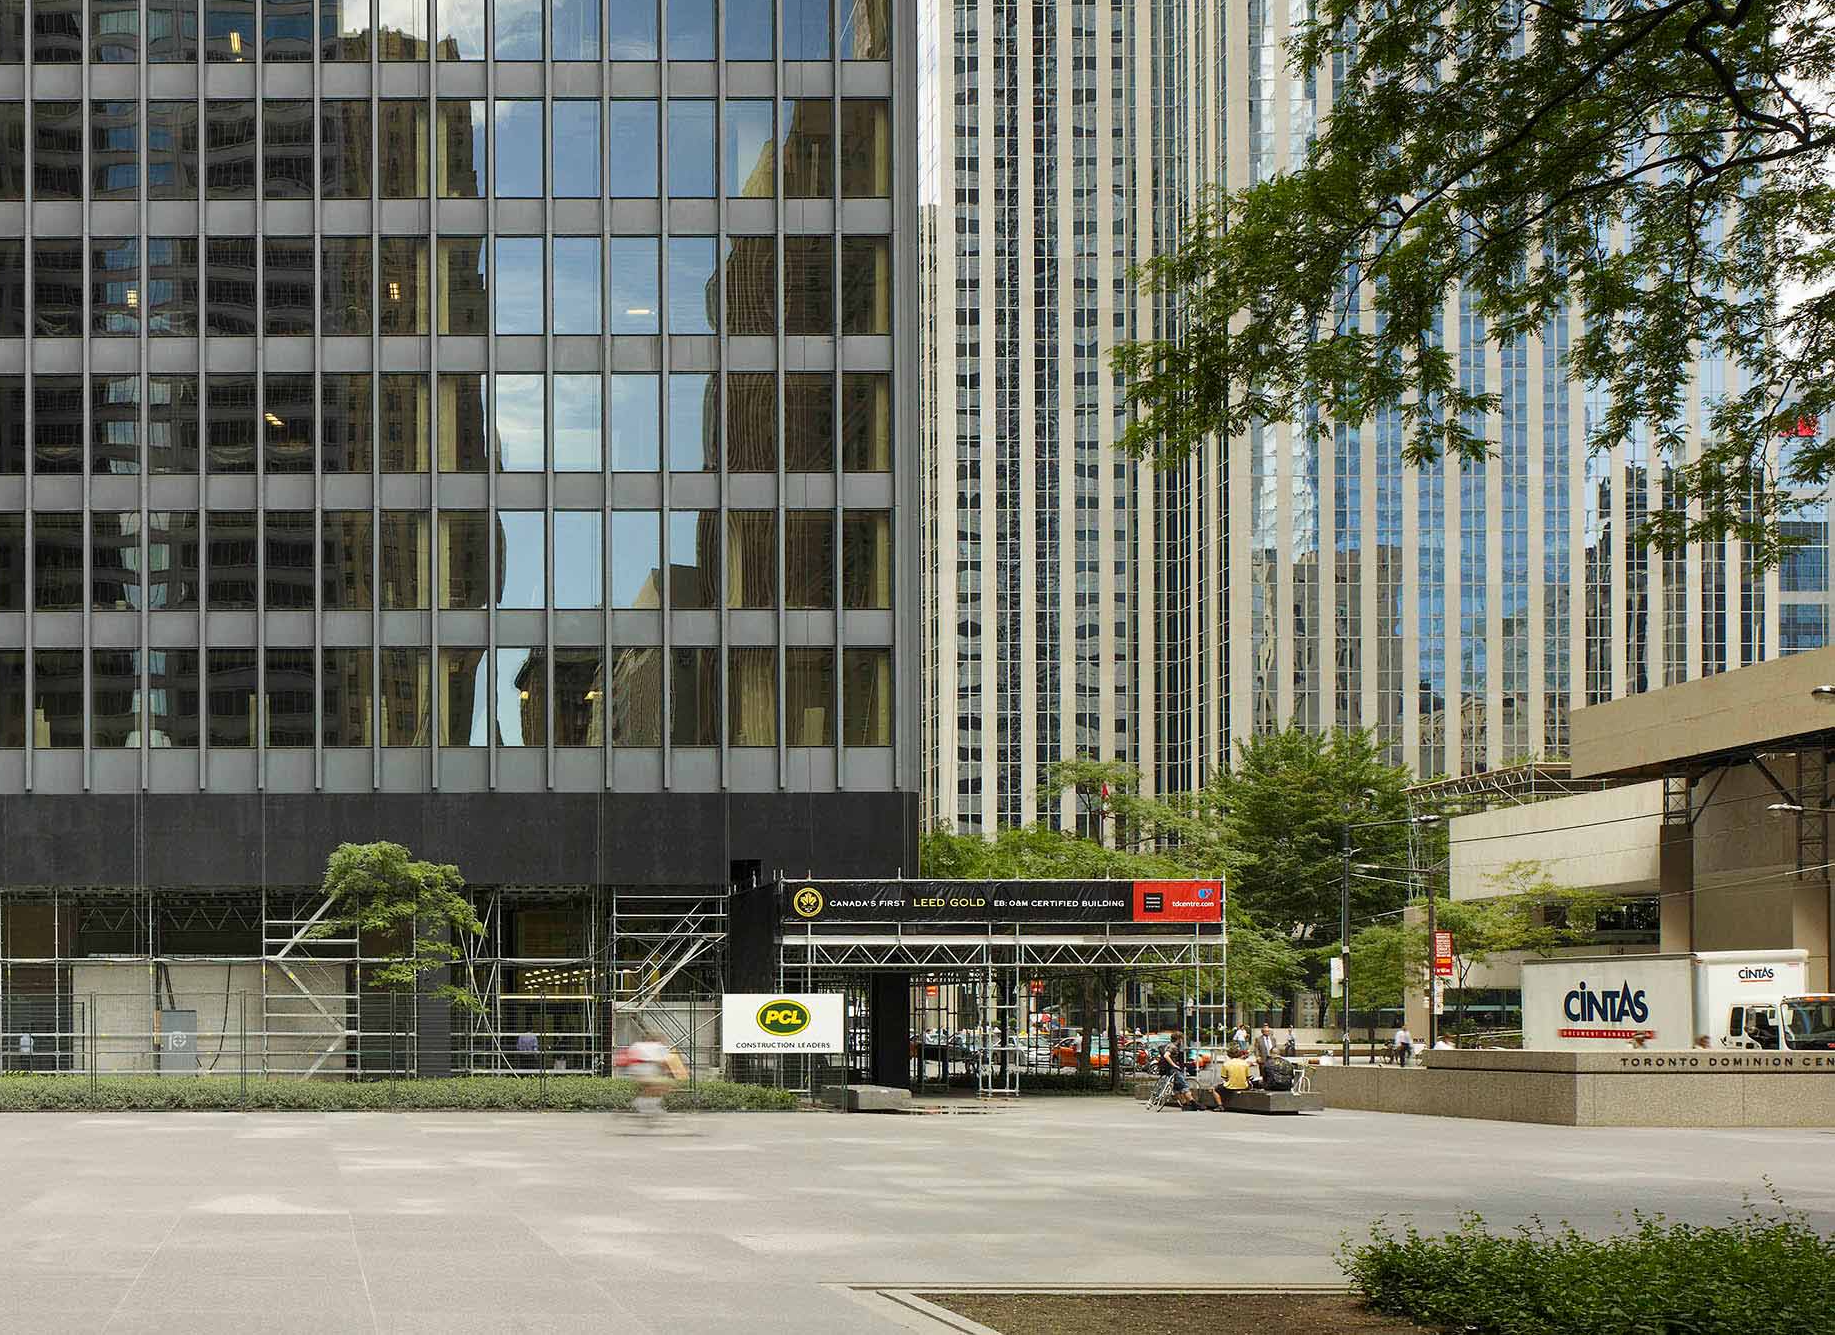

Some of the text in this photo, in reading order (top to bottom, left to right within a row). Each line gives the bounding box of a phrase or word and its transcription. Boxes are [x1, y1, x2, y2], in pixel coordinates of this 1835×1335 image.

[829, 899, 877, 907] CANADA'S
[878, 899, 906, 907] FIRST
[913, 898, 945, 907] LEED
[949, 898, 986, 907] GOLD
[1030, 899, 1079, 907] CERTIFIED
[1081, 899, 1125, 907] BUILDING
[765, 1009, 802, 1025] PCL
[1620, 1057, 1835, 1067] TORONTO DOMINION CEN
